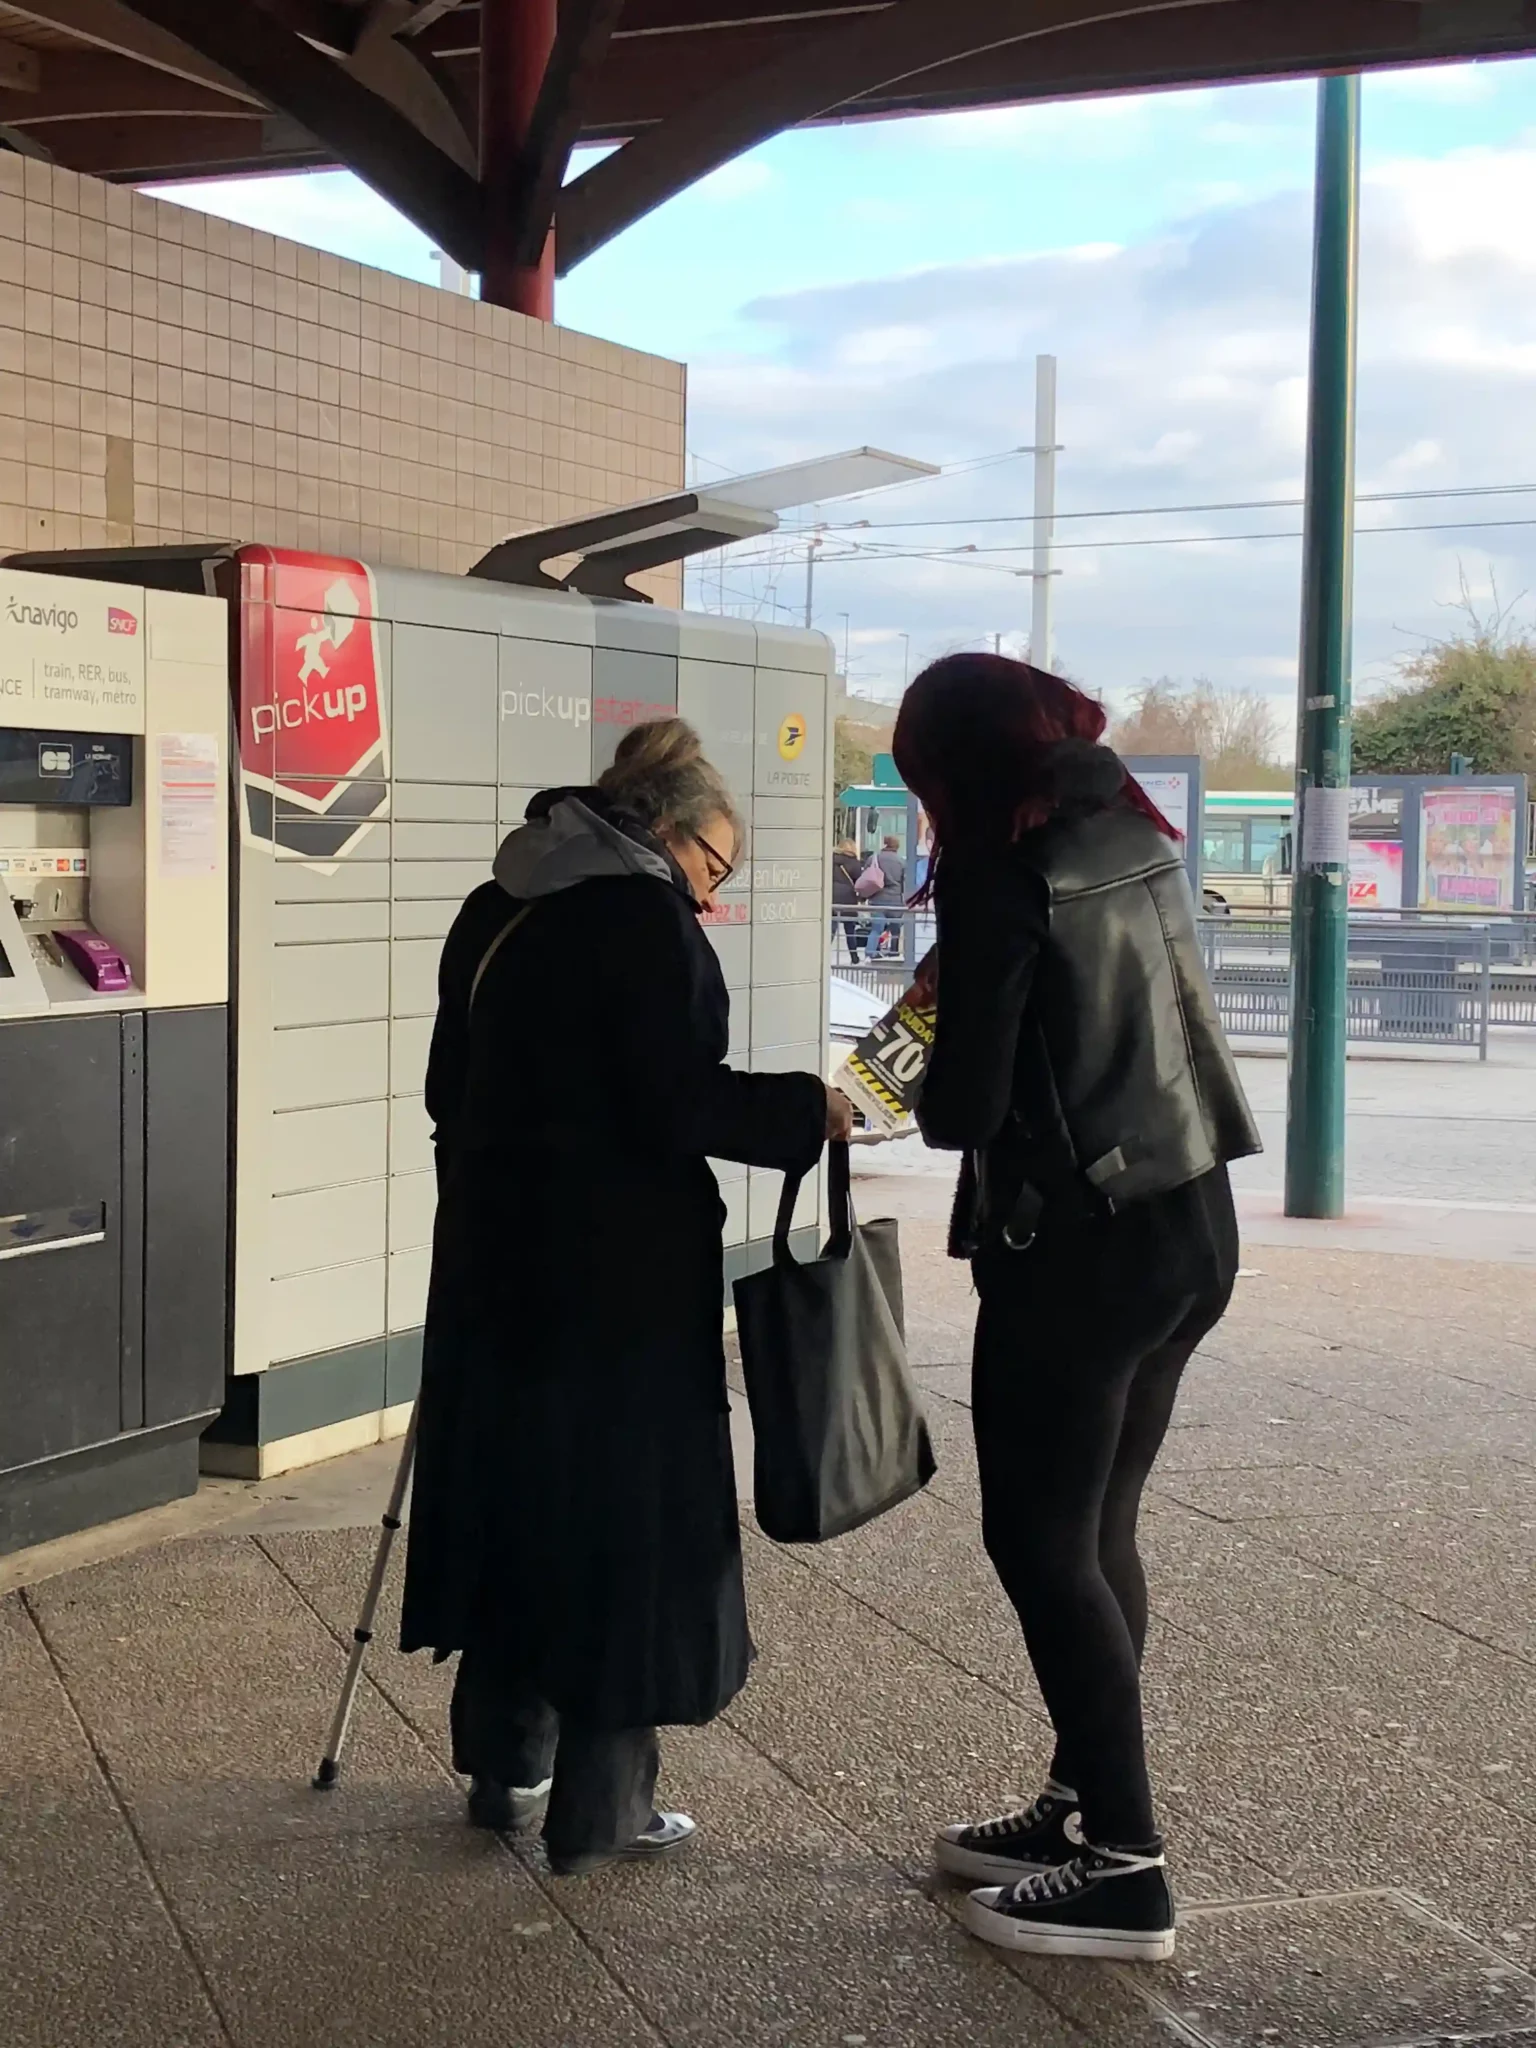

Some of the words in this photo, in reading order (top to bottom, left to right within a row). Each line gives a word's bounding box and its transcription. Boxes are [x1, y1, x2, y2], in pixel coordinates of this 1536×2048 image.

[21, 603, 78, 634] navigo
[109, 617, 137, 632] SNCF
[44, 662, 75, 682] train,
[78, 663, 105, 685] RER,
[108, 664, 131, 685] bus,
[44, 684, 99, 706] tramway,
[501, 681, 590, 727] pickup
[251, 683, 367, 744] pickup
